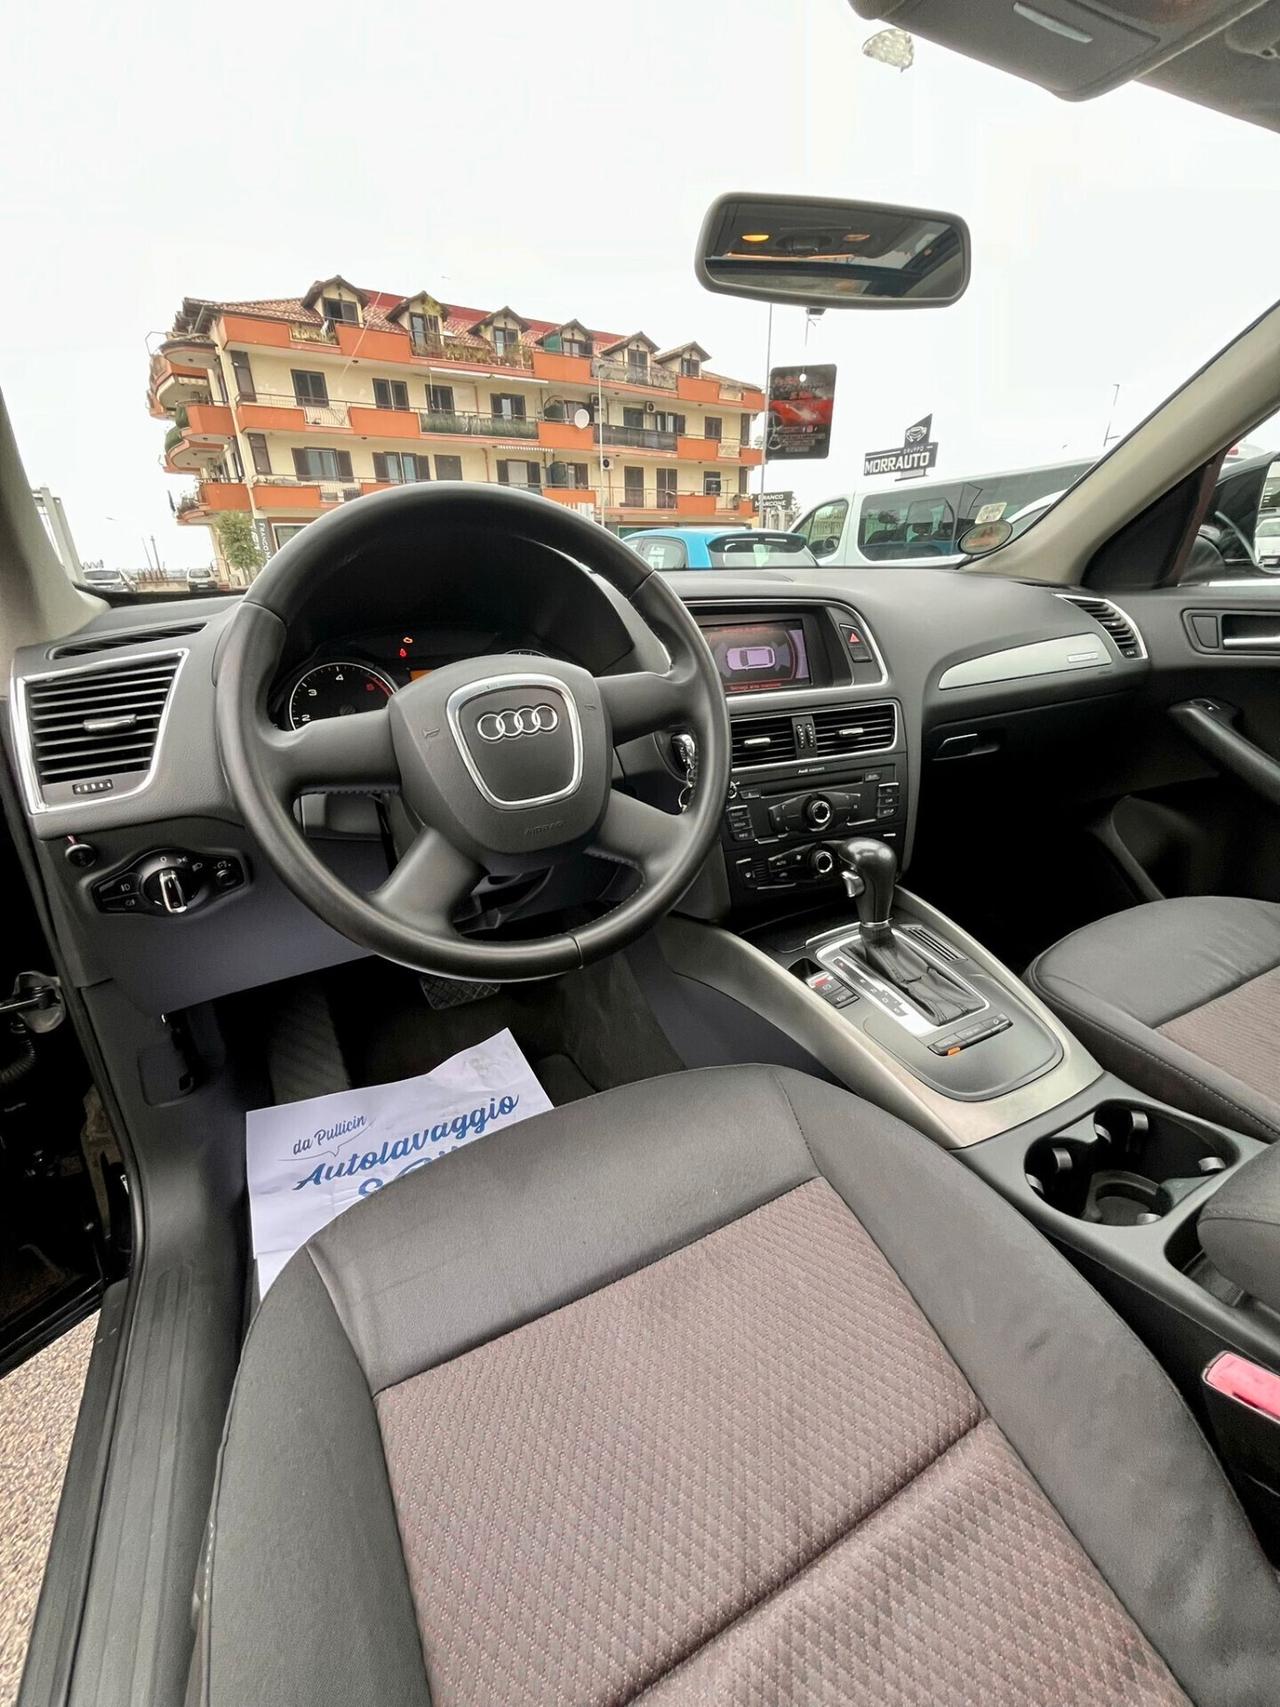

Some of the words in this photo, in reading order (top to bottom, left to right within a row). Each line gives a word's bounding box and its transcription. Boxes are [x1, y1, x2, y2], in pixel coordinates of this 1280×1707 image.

[864, 452, 930, 474] MORRAUTO
[307, 689, 318, 697] 3
[301, 714, 311, 722] 2
[291, 1093, 520, 1191] Autolavaggio
[293, 1138, 313, 1155] da
